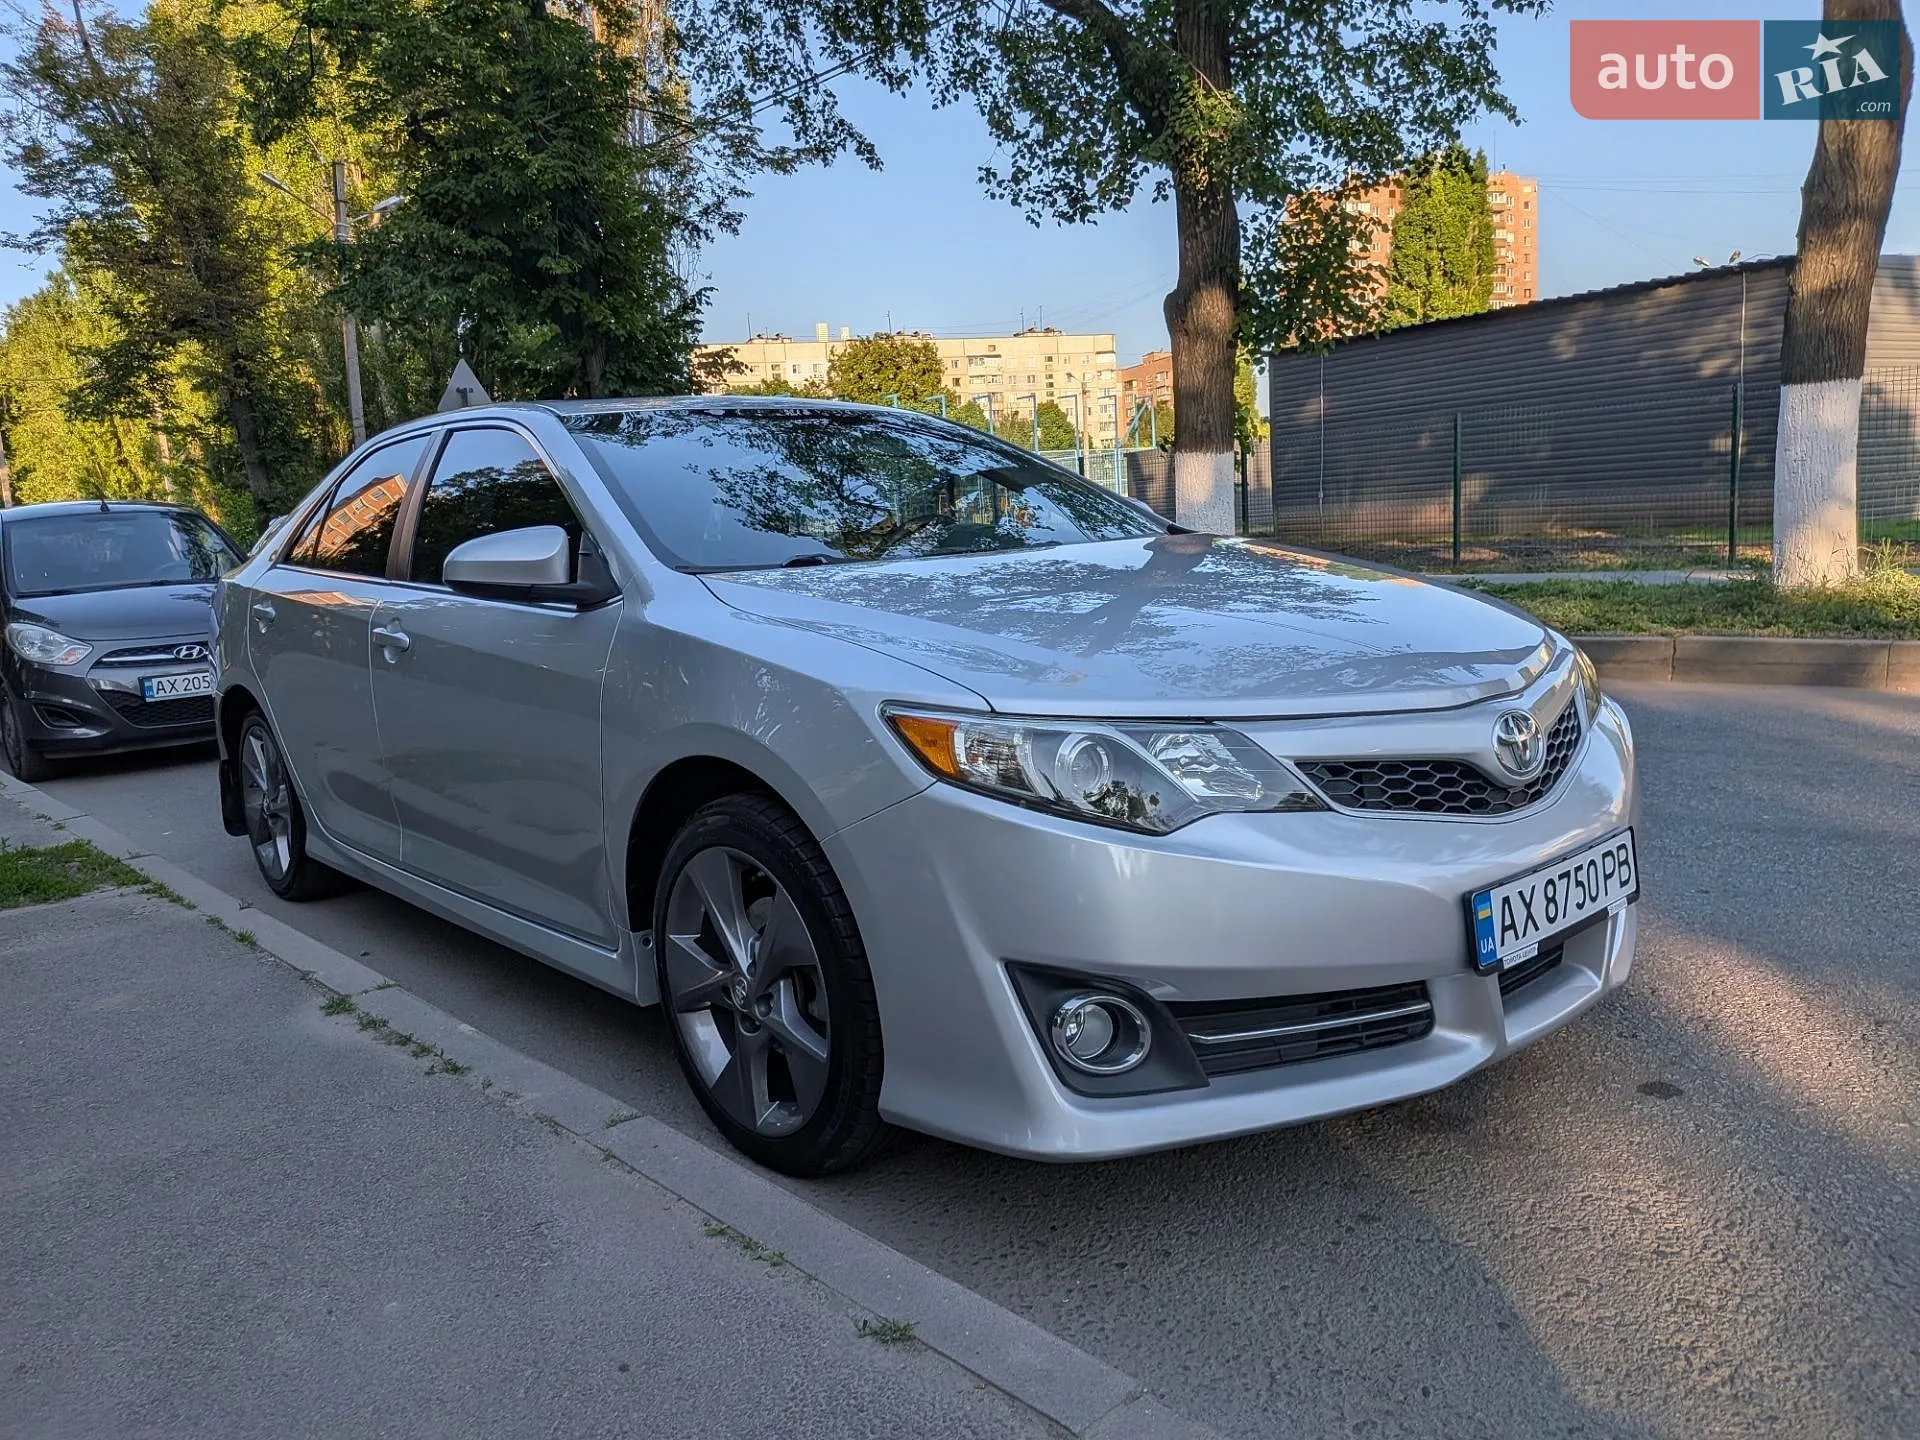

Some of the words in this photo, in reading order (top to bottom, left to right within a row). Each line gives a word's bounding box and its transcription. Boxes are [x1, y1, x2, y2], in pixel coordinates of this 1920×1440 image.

[156, 678, 179, 695] AX
[1500, 884, 1540, 947] AX
[1543, 858, 1599, 925] 8750
[1601, 842, 1632, 897] PB
[1480, 939, 1495, 954] UA
